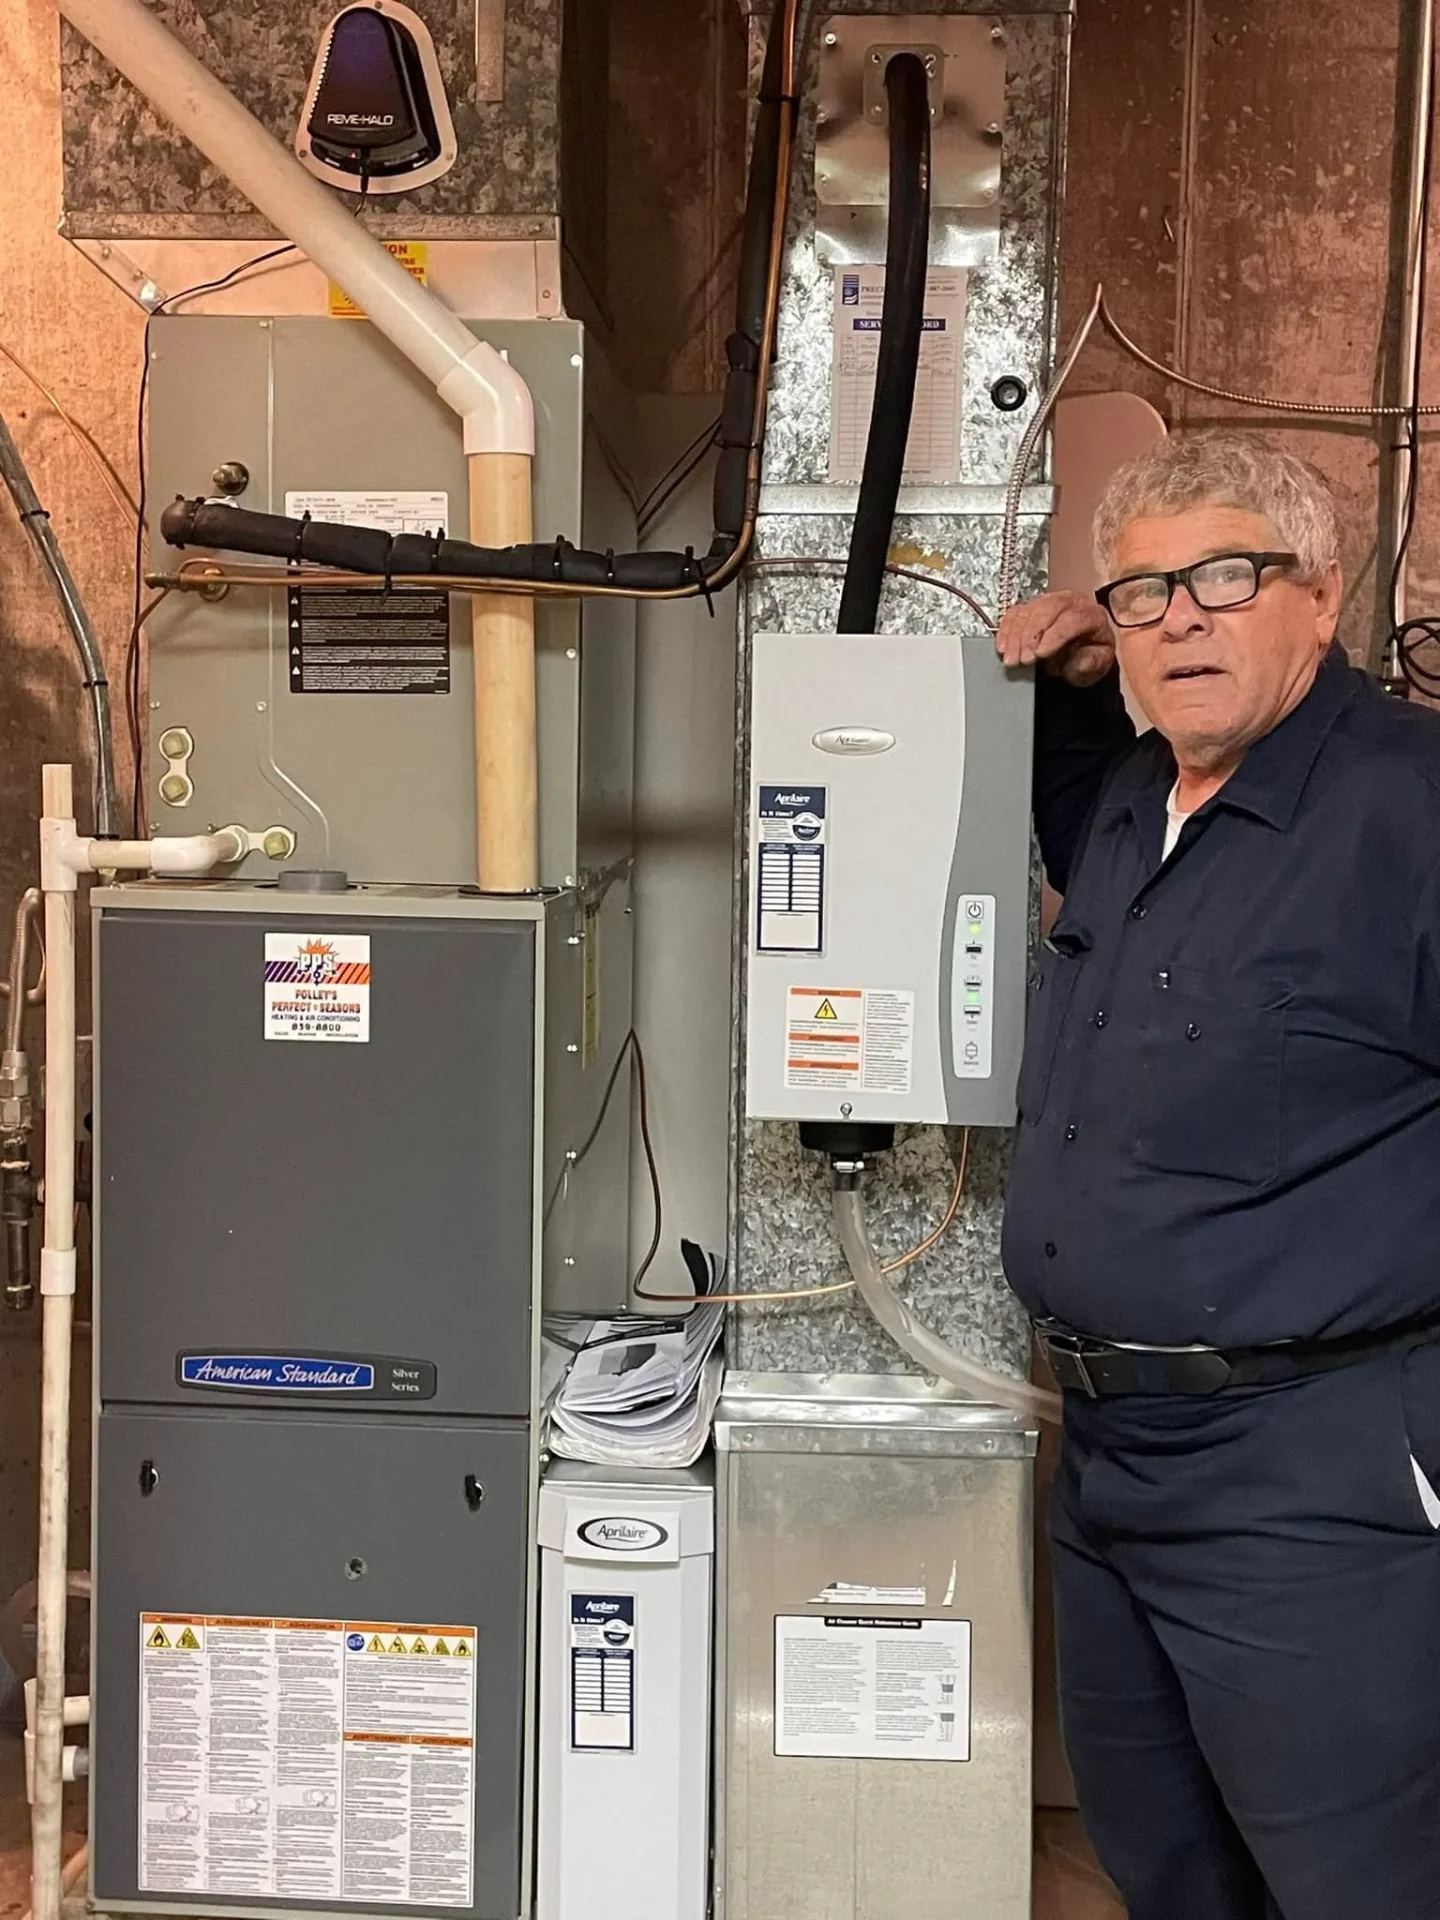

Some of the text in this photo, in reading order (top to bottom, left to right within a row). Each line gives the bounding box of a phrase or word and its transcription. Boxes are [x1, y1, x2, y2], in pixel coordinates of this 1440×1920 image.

[300, 952, 335, 972] PPS
[271, 1001, 361, 1014] PERFECT SEASONS
[195, 1359, 358, 1386] American Standard
[392, 1367, 420, 1380] Silver
[391, 1381, 420, 1393] Series
[597, 1524, 646, 1543] Aprilaire
